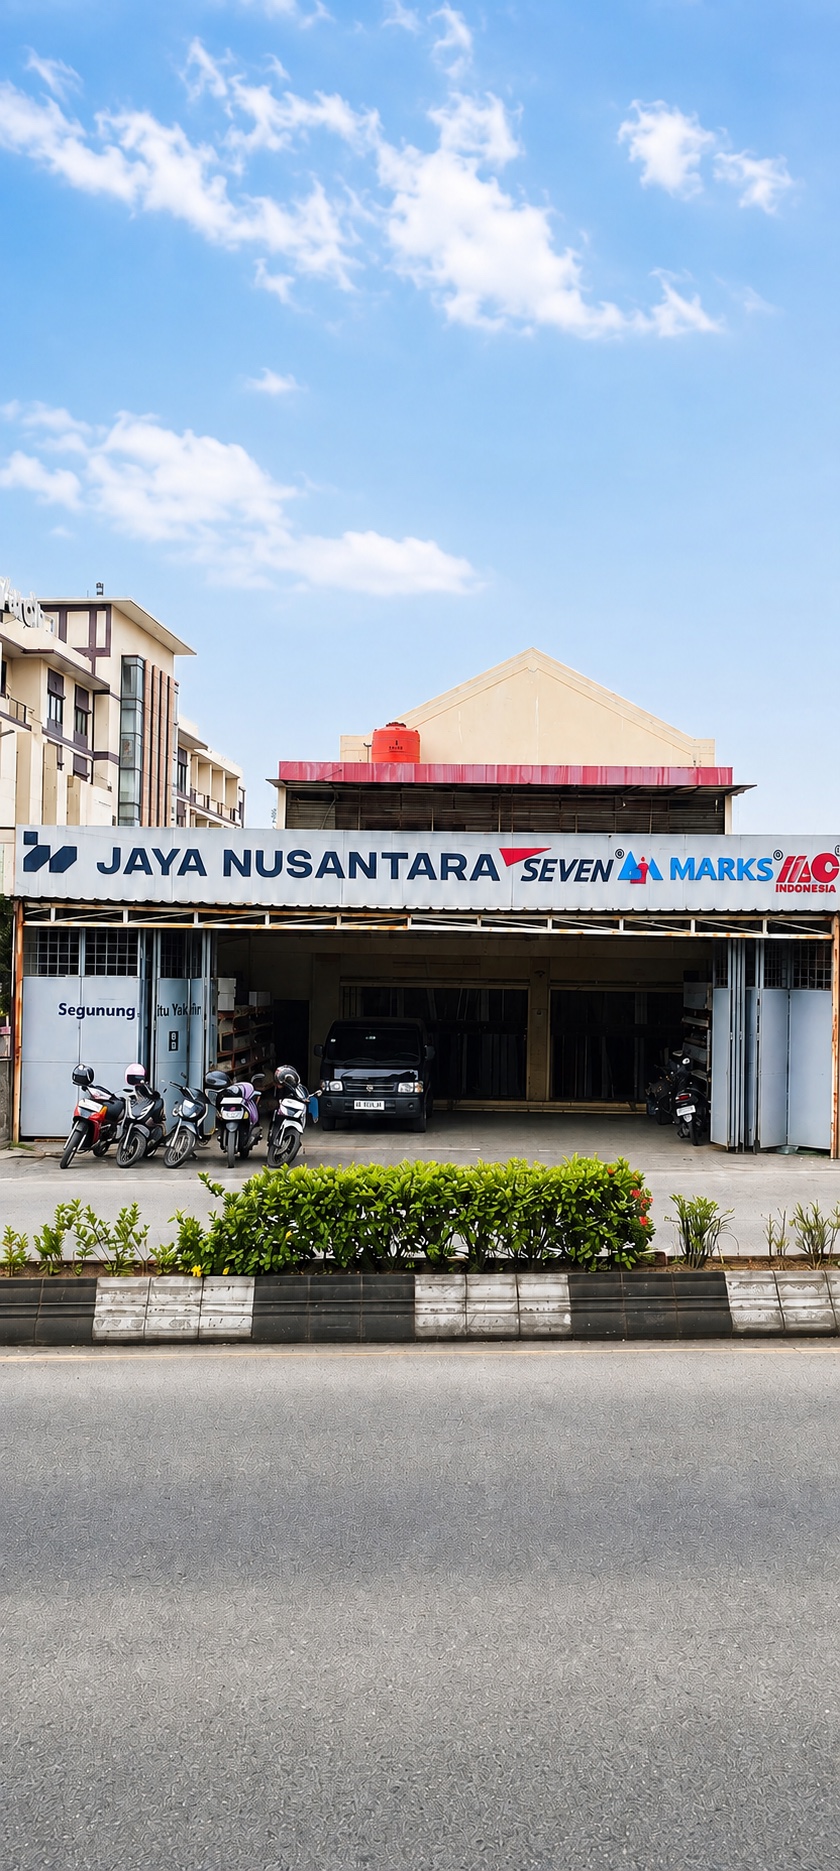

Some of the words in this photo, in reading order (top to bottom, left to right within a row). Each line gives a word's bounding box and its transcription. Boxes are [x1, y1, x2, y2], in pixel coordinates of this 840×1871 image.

[96, 846, 207, 876] JAYA
[223, 848, 500, 882] NUSANTARA
[520, 858, 614, 883] SEVEN
[669, 857, 774, 882] MARKS
[775, 883, 837, 893] INDONESIA
[58, 1002, 136, 1020] Segunung
